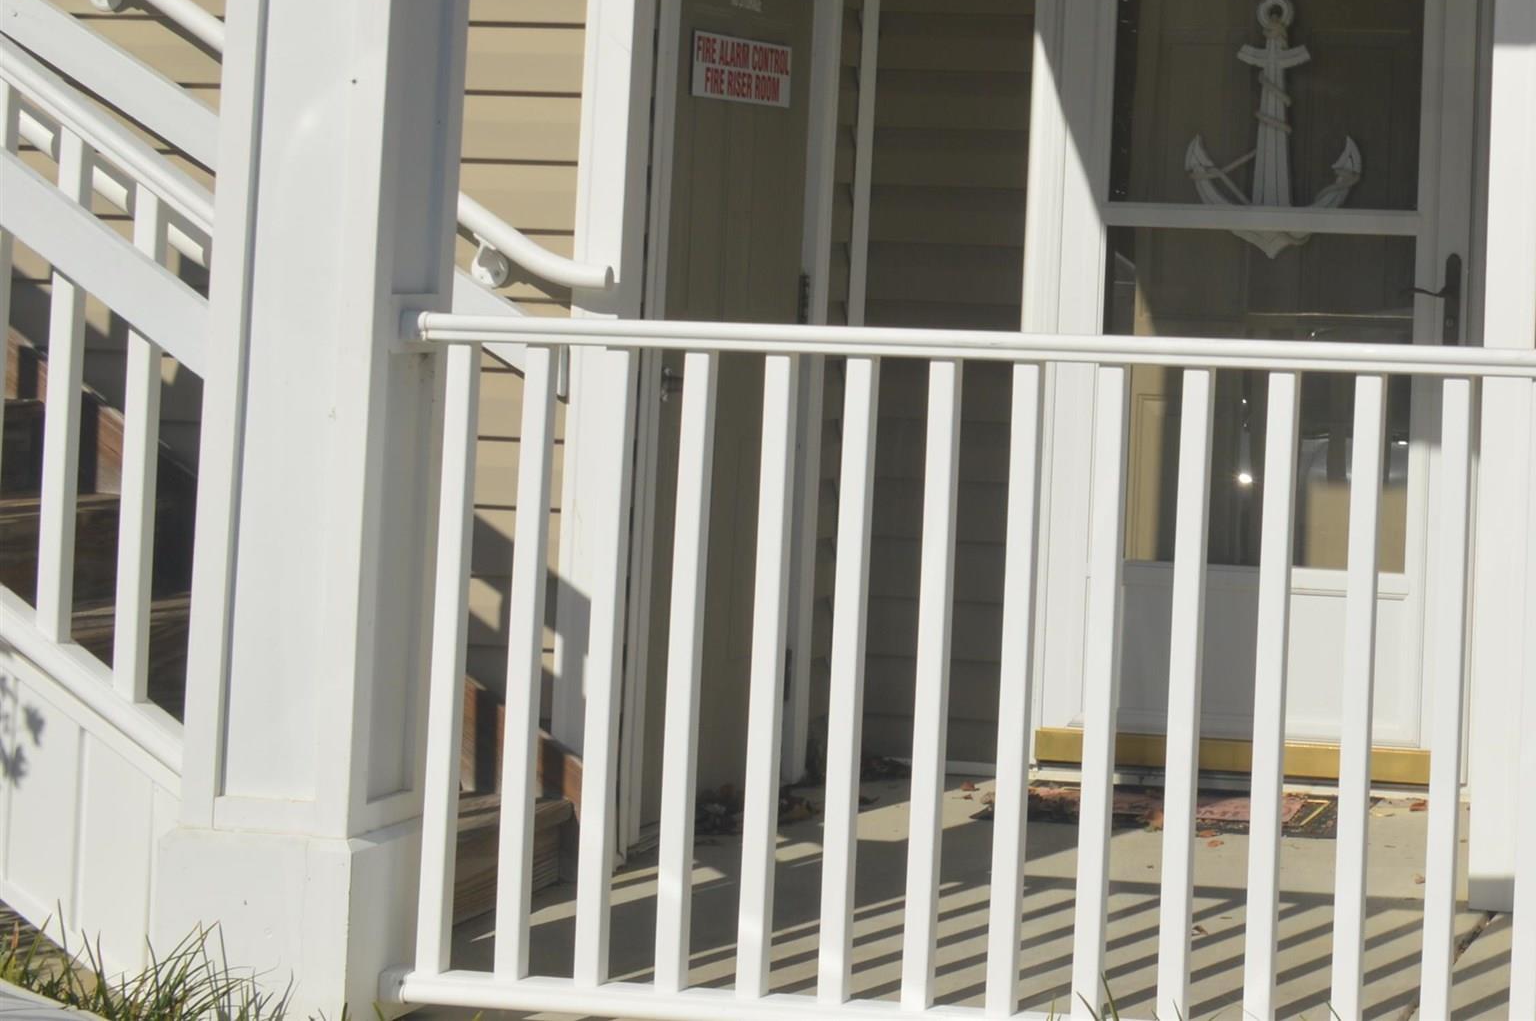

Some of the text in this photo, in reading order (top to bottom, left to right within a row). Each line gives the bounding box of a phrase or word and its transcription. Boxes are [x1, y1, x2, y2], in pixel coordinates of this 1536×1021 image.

[696, 35, 789, 75] FIRE ALARM CONTROL
[704, 66, 780, 102] FIRE RISER ROOM
